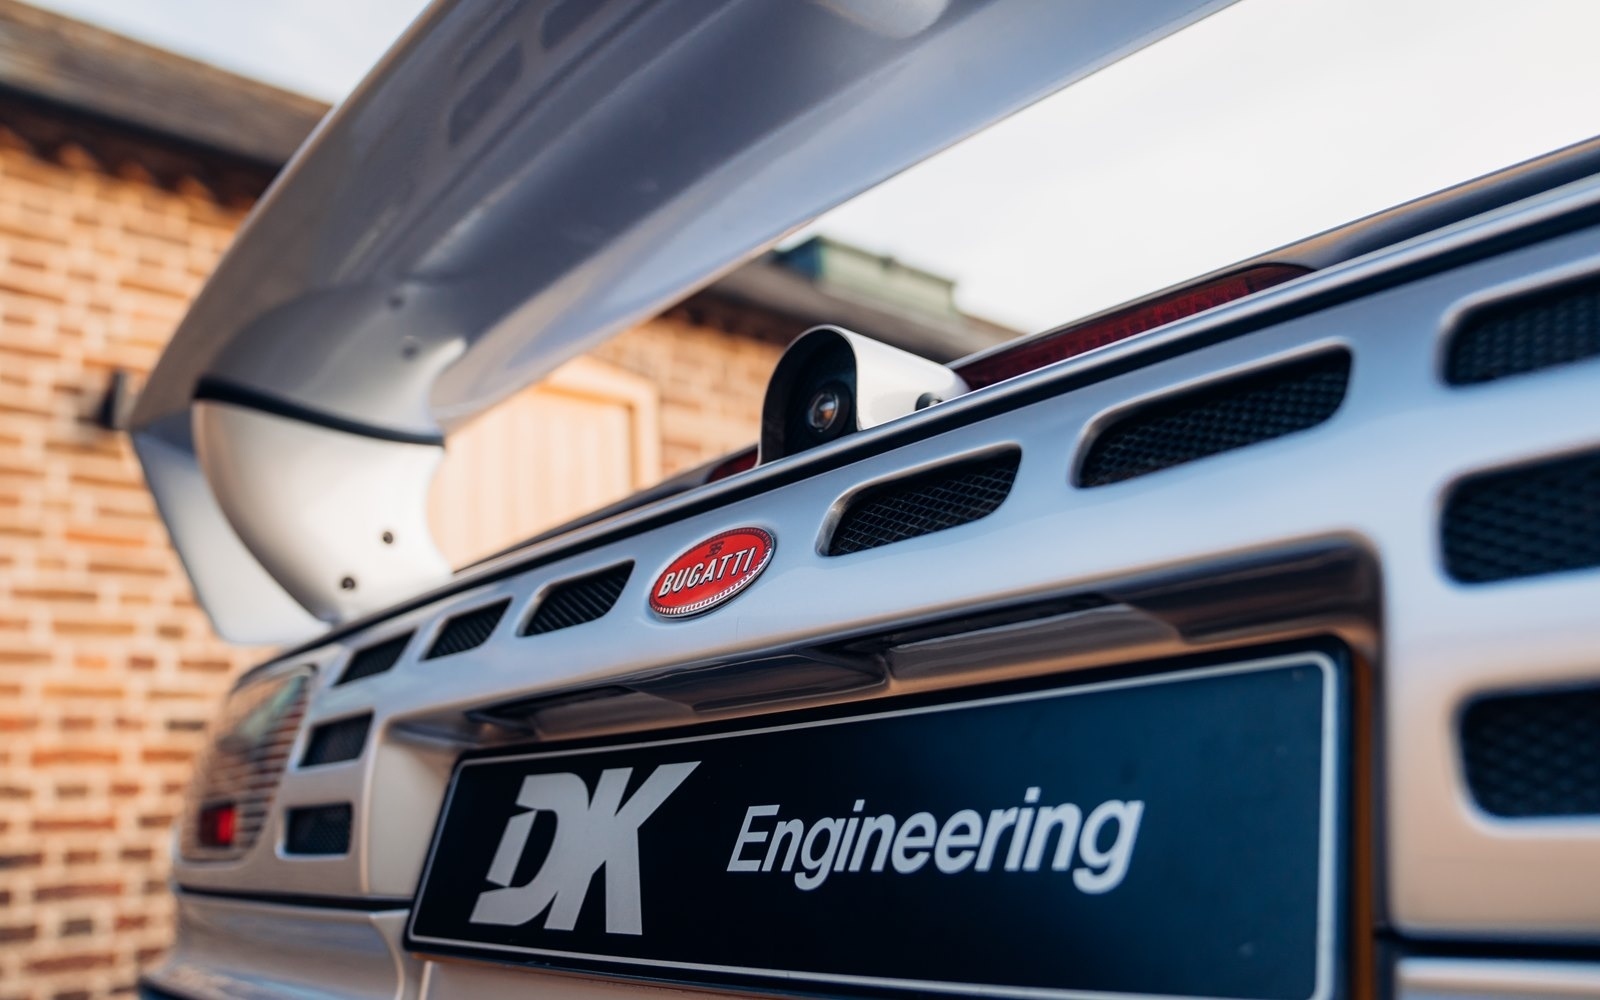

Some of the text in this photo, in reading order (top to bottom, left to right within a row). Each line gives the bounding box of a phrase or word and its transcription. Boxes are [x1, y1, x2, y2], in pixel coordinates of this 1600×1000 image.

[657, 547, 756, 598] BUGATTI
[469, 761, 1145, 935] DK Engineering
